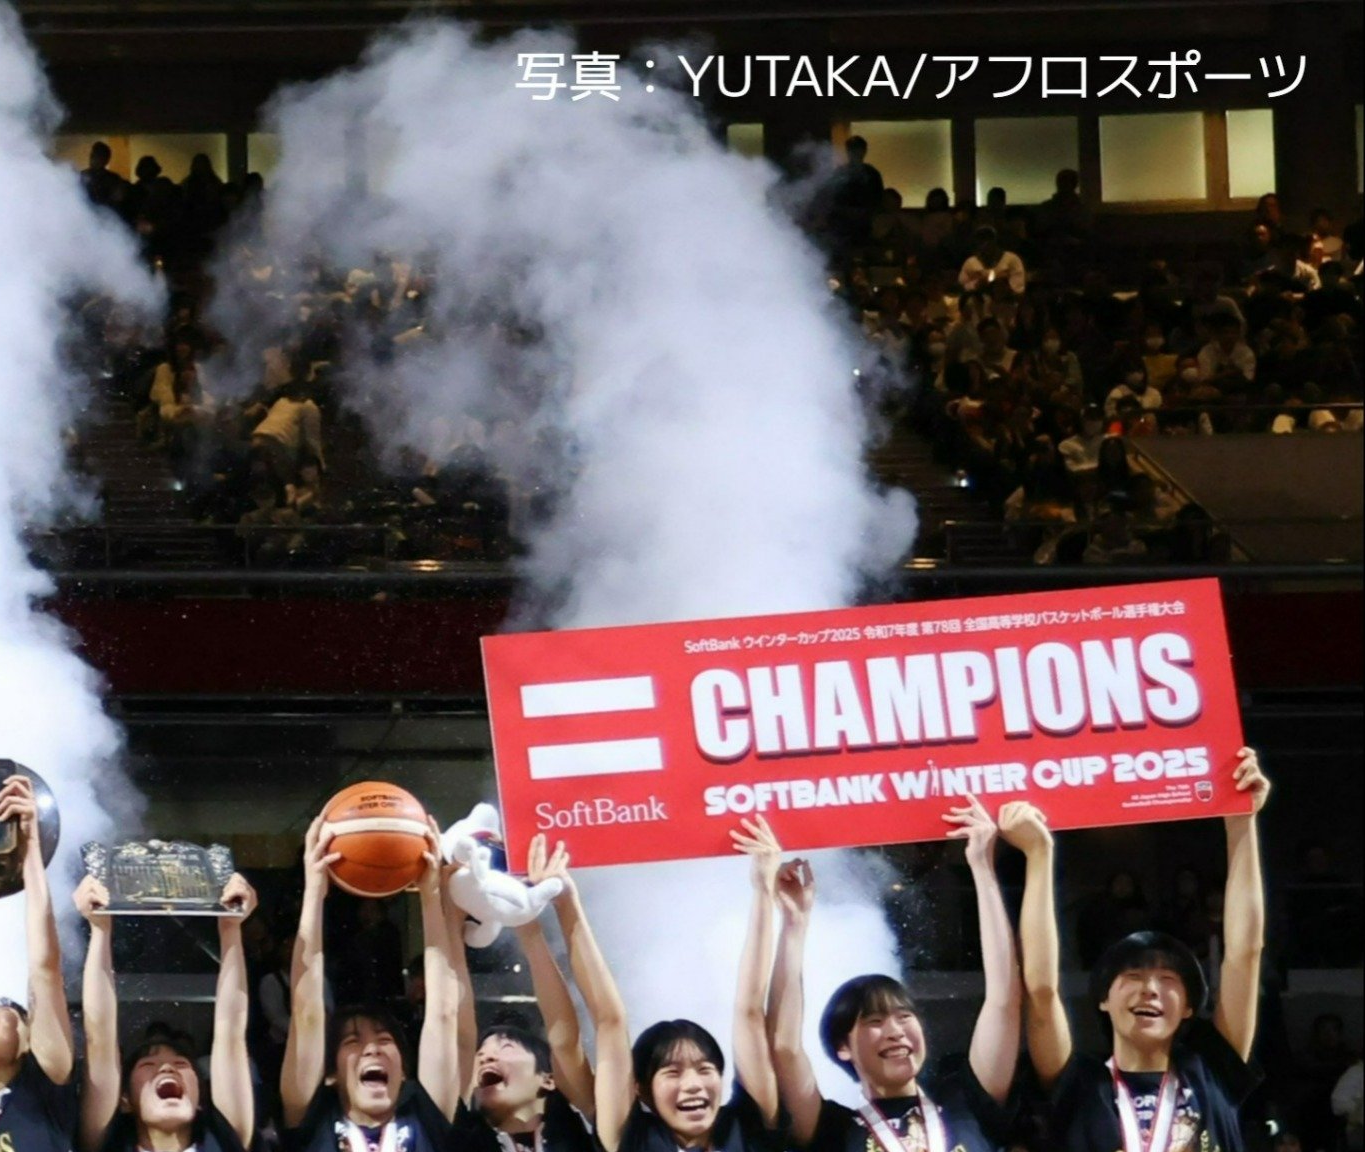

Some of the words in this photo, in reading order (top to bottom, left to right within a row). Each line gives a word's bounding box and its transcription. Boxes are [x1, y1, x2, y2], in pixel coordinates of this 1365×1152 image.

[684, 637, 741, 655] SoftBank
[688, 630, 1203, 764] CHAMPIONS
[703, 772, 882, 817] SOFTBANK
[887, 757, 1026, 799] WINTER
[1032, 755, 1109, 790] CUP
[1111, 746, 1211, 783] 2025
[535, 796, 668, 831] SoftBank
